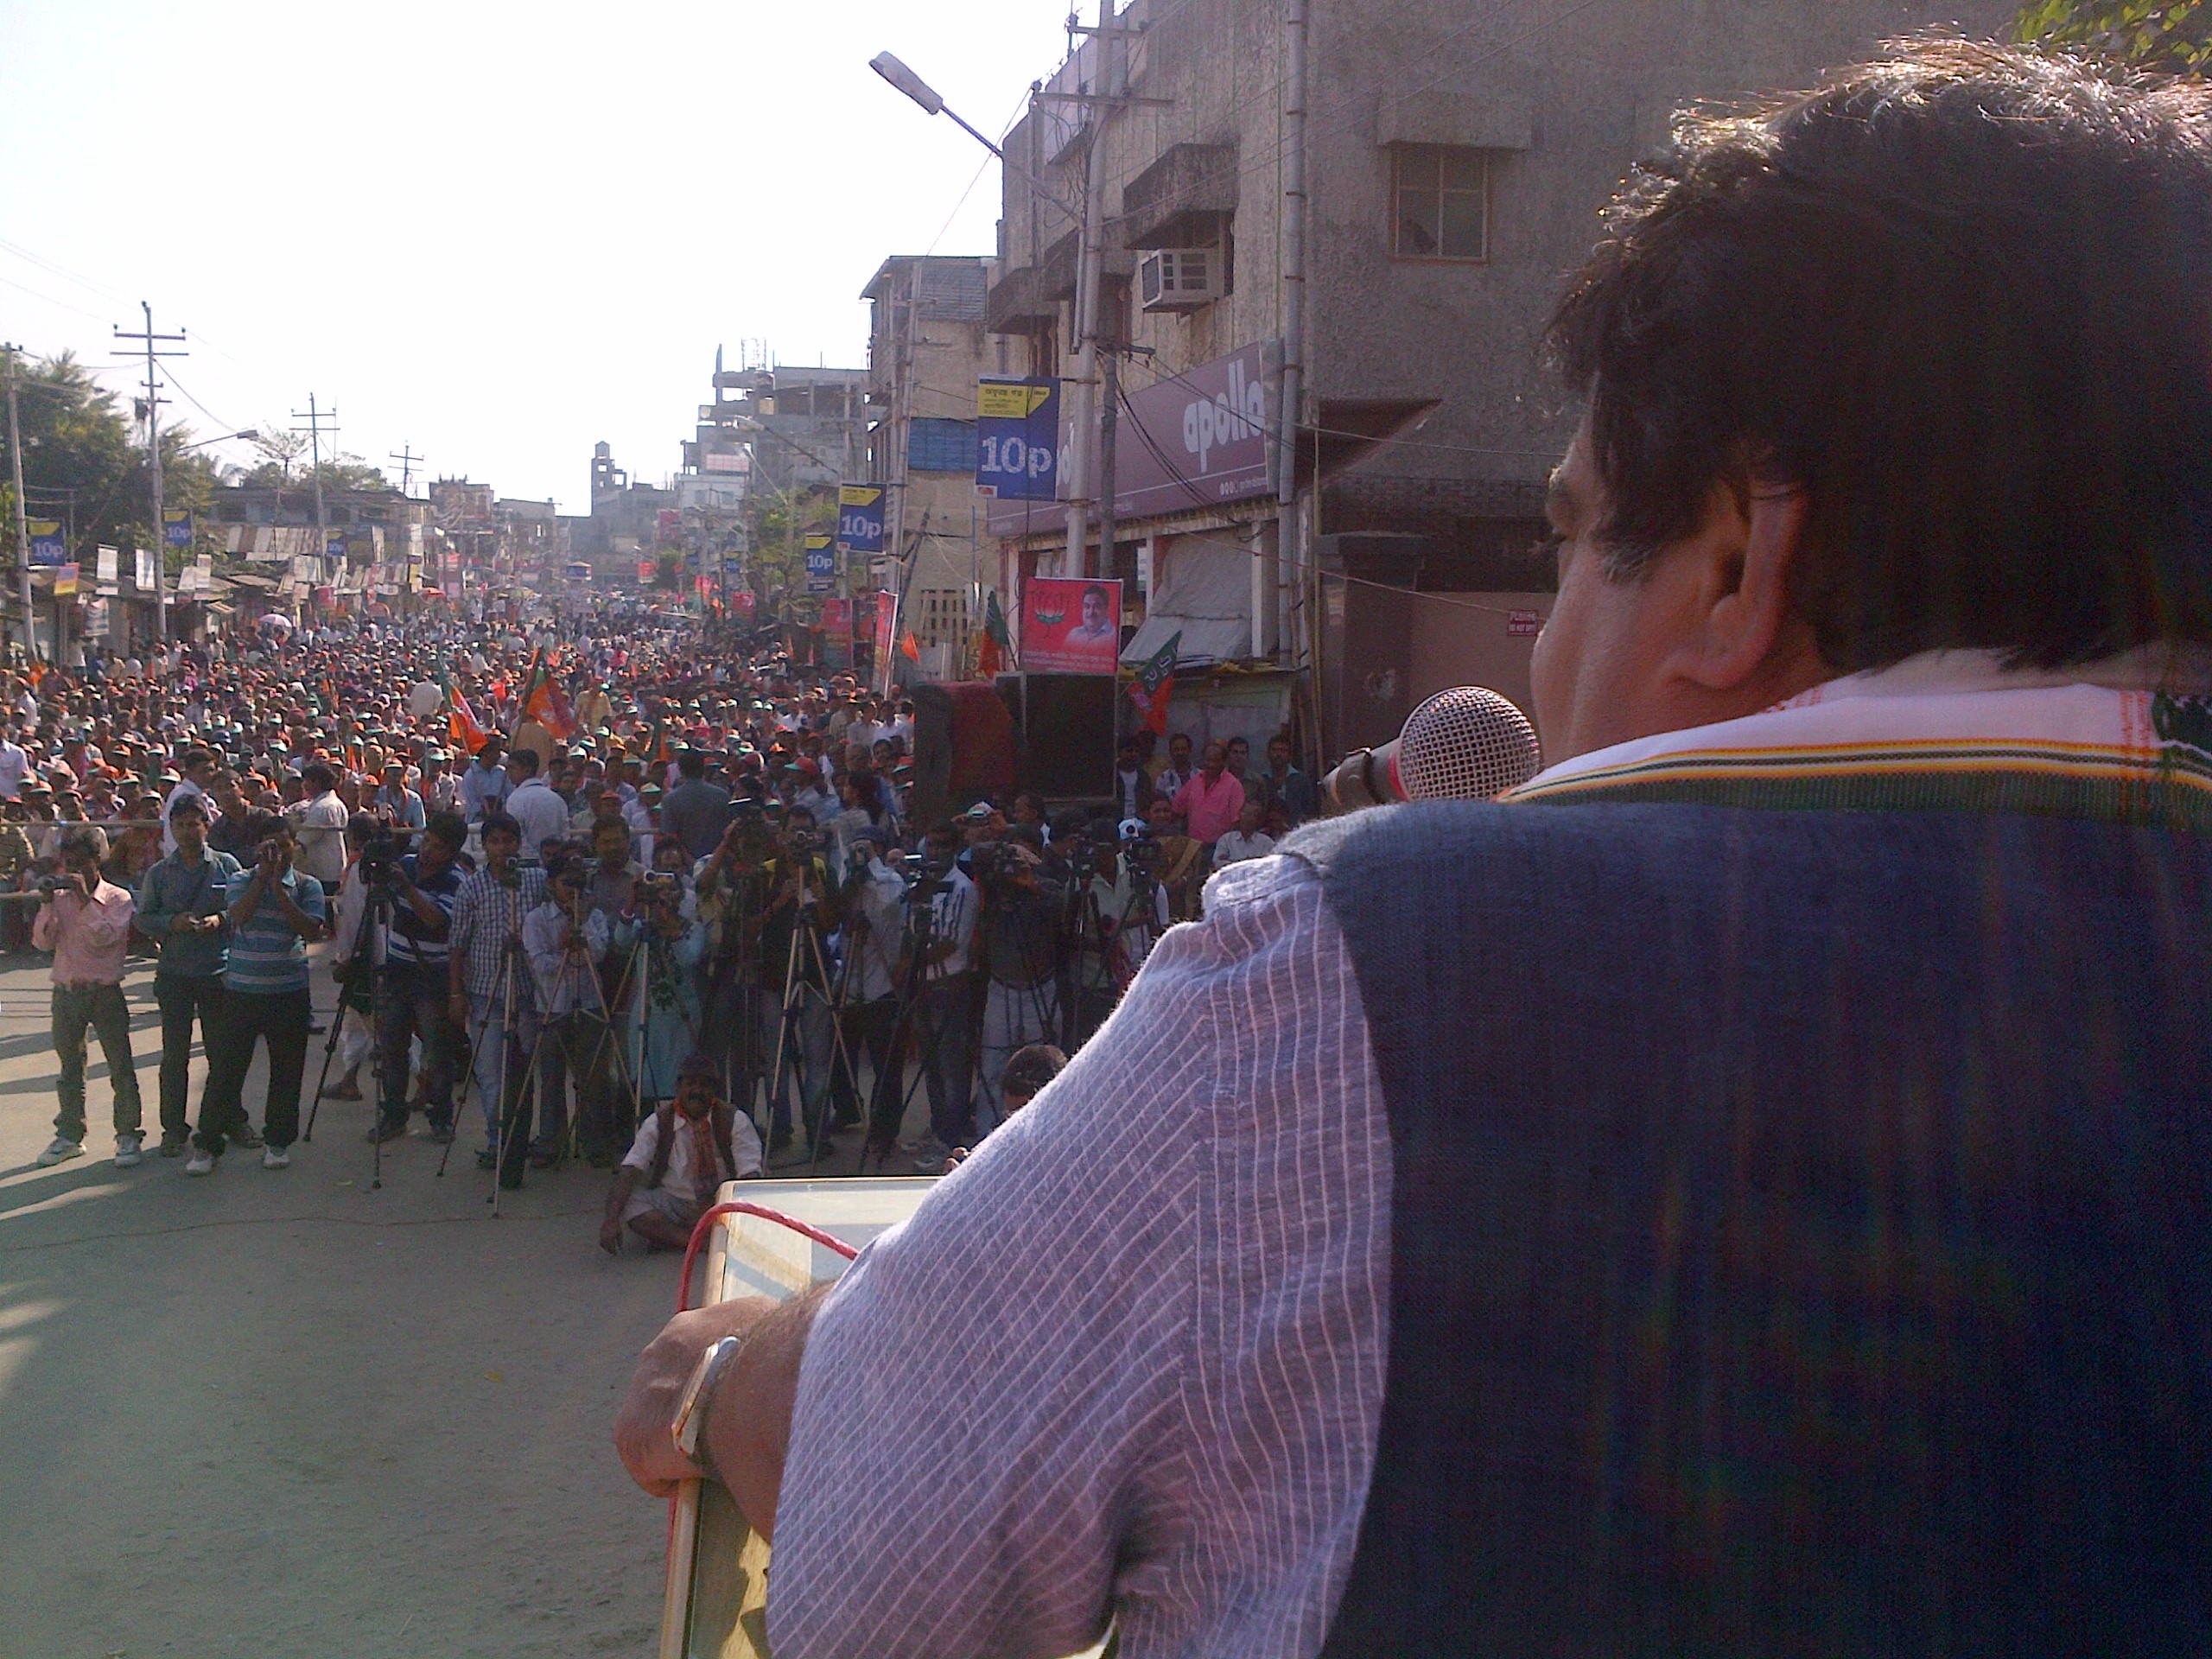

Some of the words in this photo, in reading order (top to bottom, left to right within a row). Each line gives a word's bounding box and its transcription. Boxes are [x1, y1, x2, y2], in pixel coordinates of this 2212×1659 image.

[1183, 359, 1266, 473] apollo
[982, 435, 1052, 479] 10p
[167, 525, 192, 539] 10p
[840, 515, 881, 539] 10p
[33, 542, 64, 558] 10p
[807, 554, 834, 569] 10p
